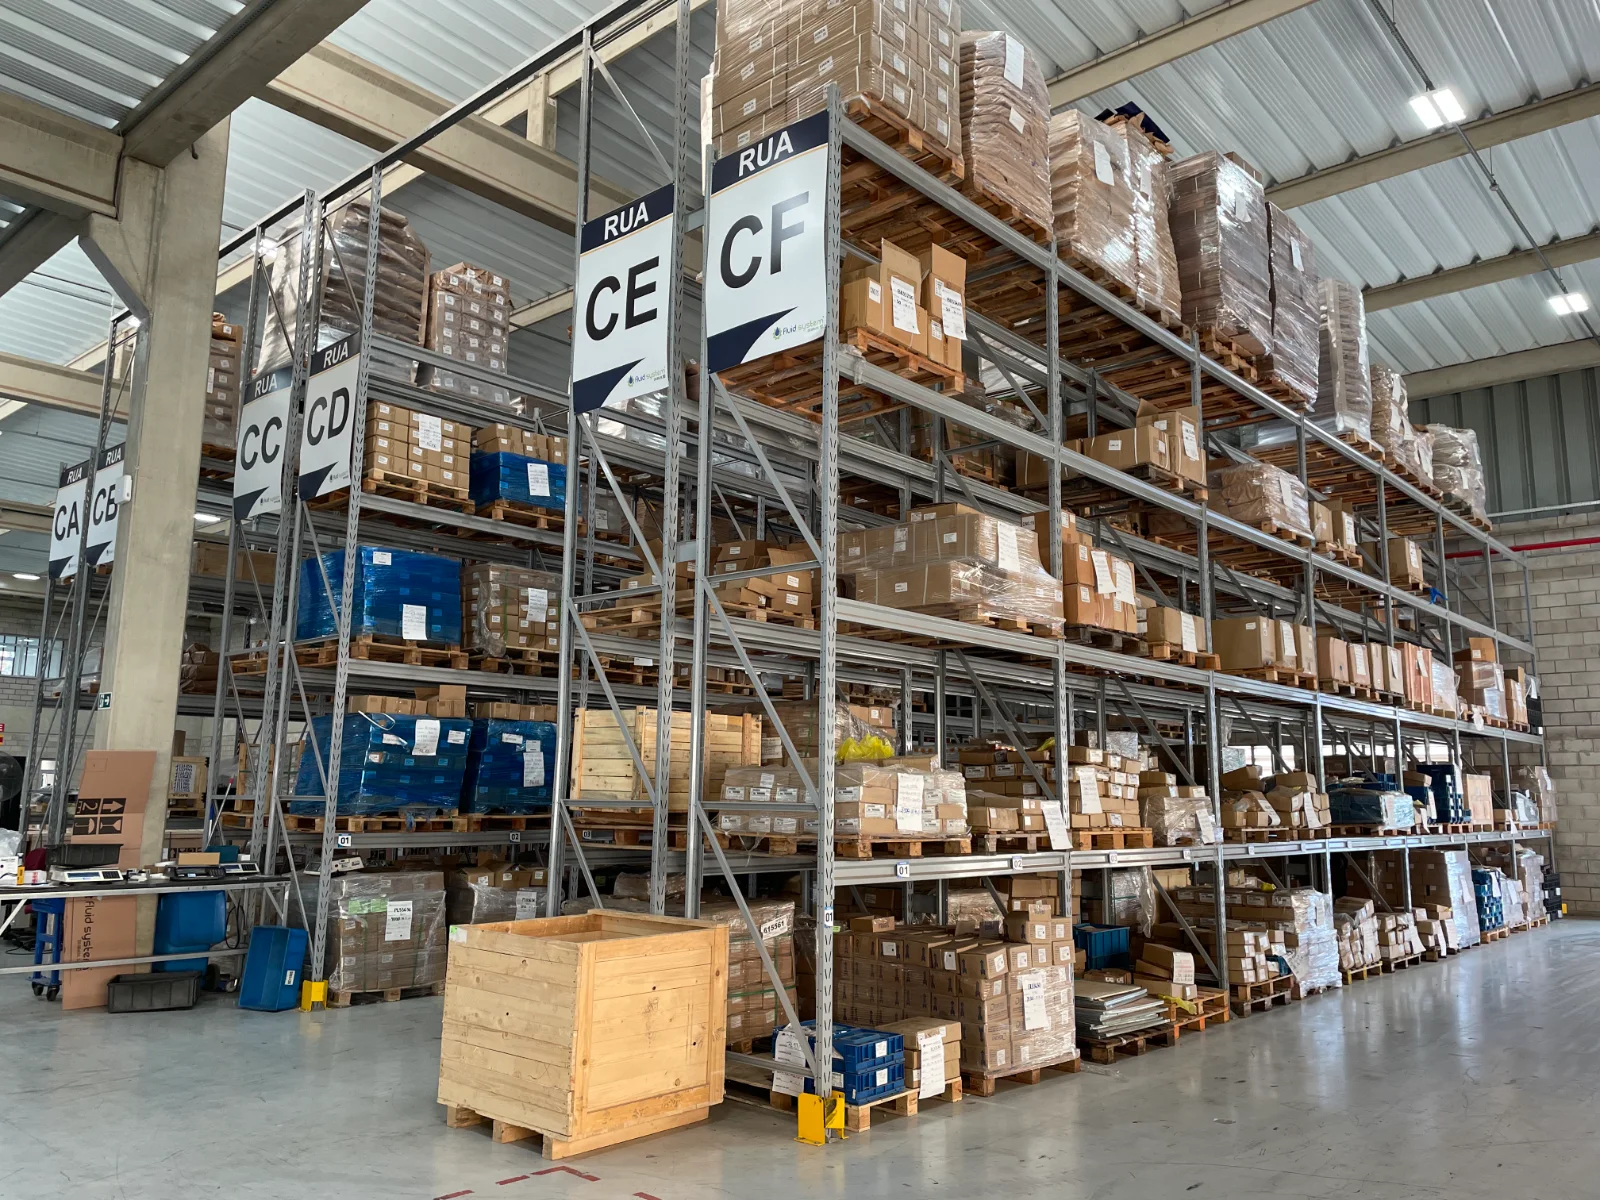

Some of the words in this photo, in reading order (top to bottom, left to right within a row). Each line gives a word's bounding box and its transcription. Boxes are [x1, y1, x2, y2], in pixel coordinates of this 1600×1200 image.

[738, 130, 794, 177] RUA
[603, 201, 649, 241] RUA
[720, 190, 810, 289] CF
[585, 255, 660, 341] CE
[323, 341, 349, 368] RUA
[254, 373, 278, 397] RUA
[307, 387, 350, 446] CD
[105, 447, 122, 466] RUA
[240, 416, 283, 471] CC
[67, 467, 83, 484] RUA
[93, 483, 118, 526] CB
[54, 501, 80, 541] CA
[340, 836, 350, 845] 01
[511, 833, 519, 841] 02
[898, 866, 909, 875] 01
[1013, 860, 1022, 868] 02
[825, 912, 833, 922] 01
[81, 926, 94, 962] syste
